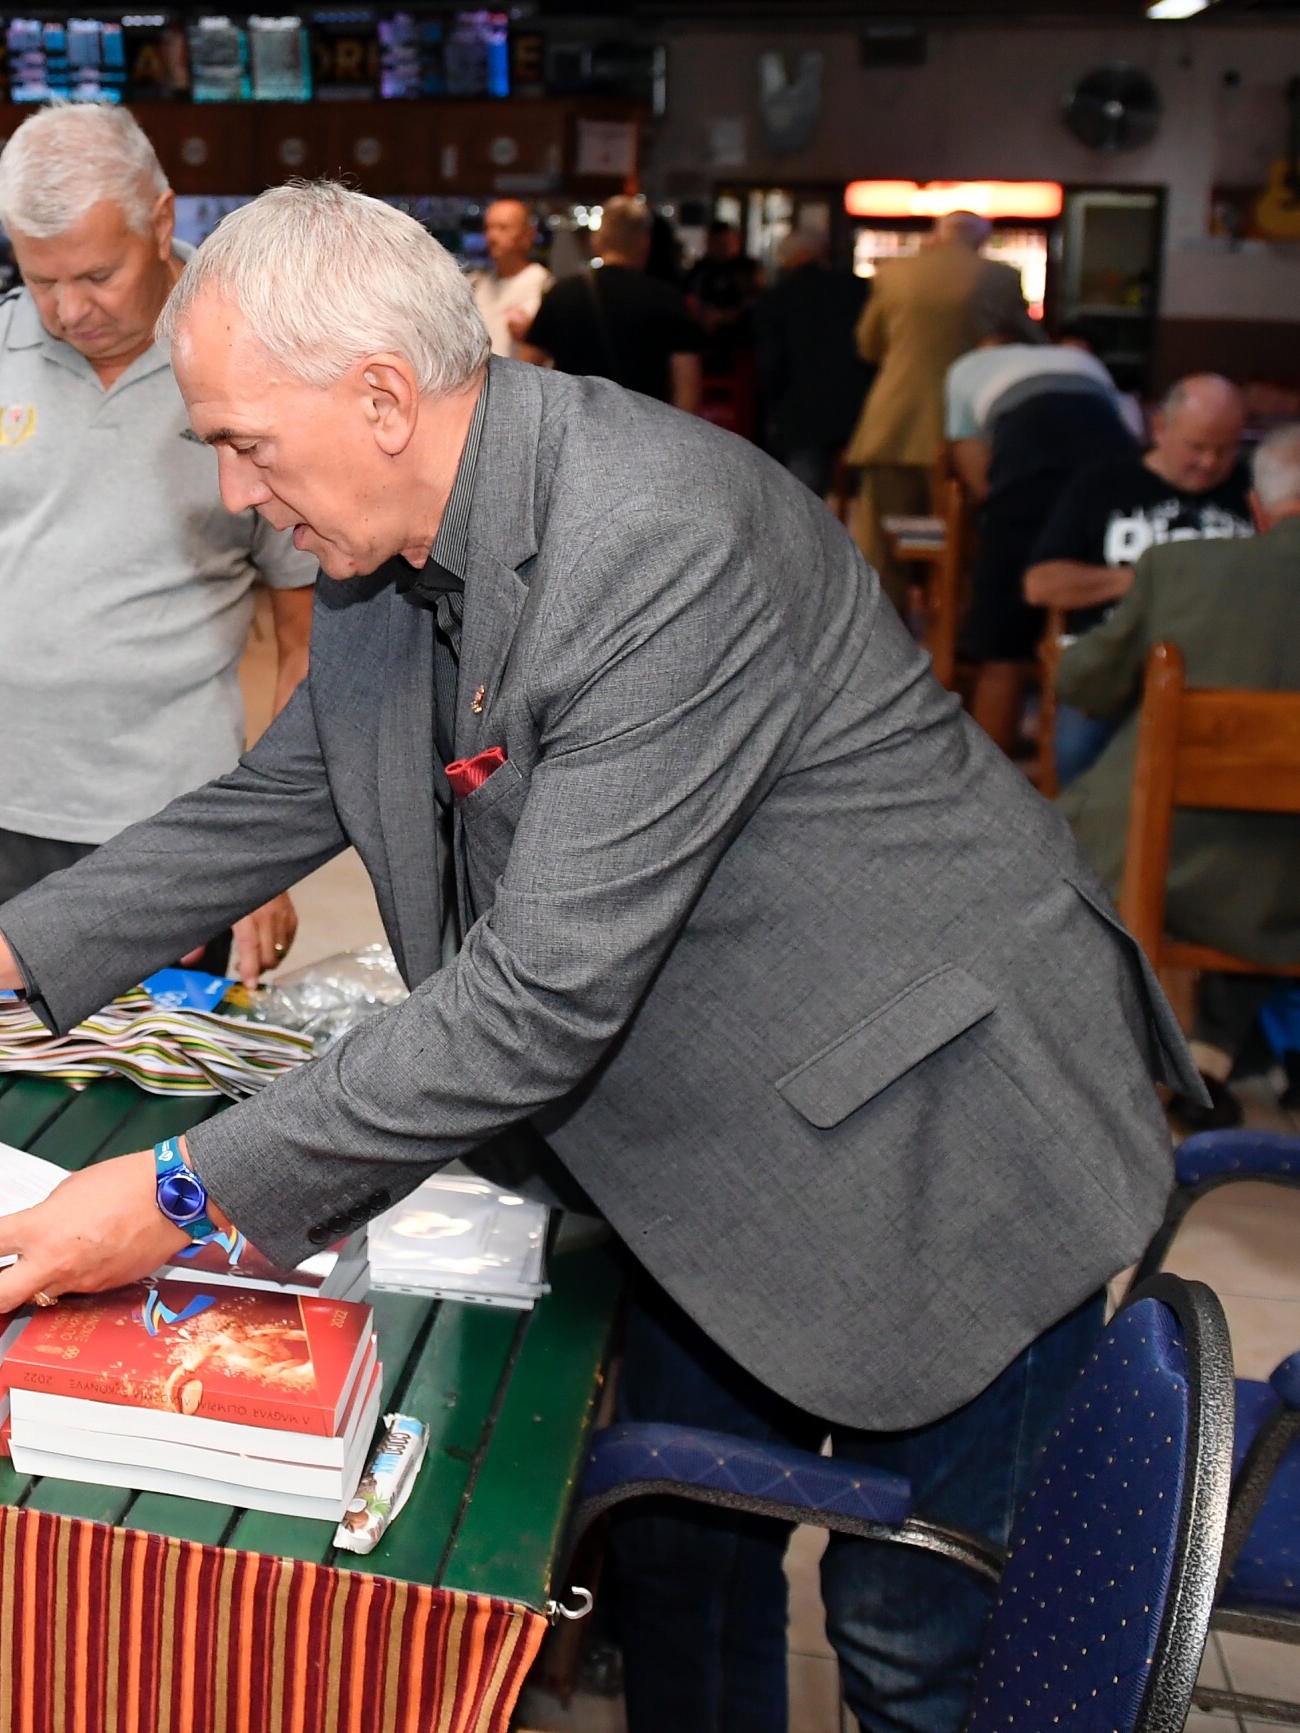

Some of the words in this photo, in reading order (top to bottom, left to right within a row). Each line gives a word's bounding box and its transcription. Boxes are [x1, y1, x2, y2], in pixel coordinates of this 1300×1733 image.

[331, 1310, 348, 1328] 2022
[23, 1371, 53, 1385] 2022
[252, 1408, 298, 1424] MAGYAR
